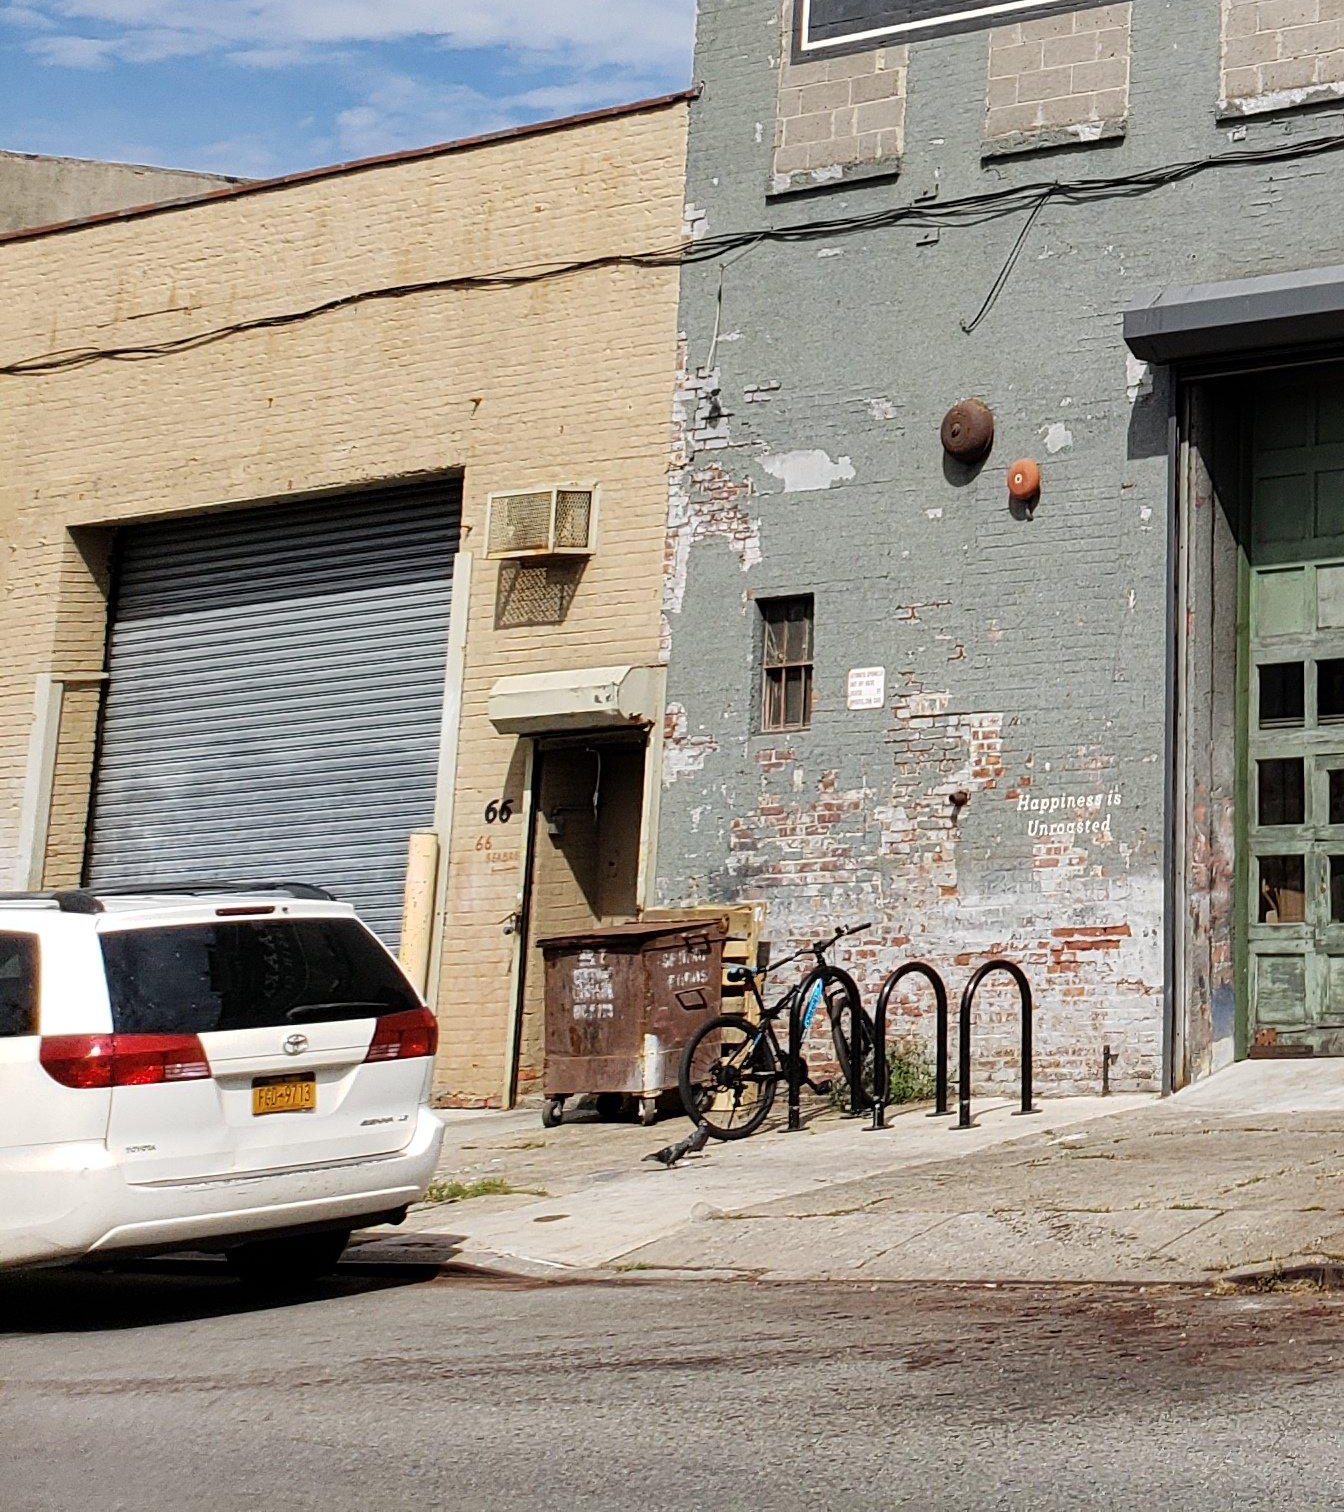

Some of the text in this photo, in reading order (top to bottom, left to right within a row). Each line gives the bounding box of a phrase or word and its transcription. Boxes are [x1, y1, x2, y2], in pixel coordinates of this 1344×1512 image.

[485, 798, 514, 823] 66
[1016, 791, 1104, 815] Happiness
[1027, 812, 1112, 837] Unroasted
